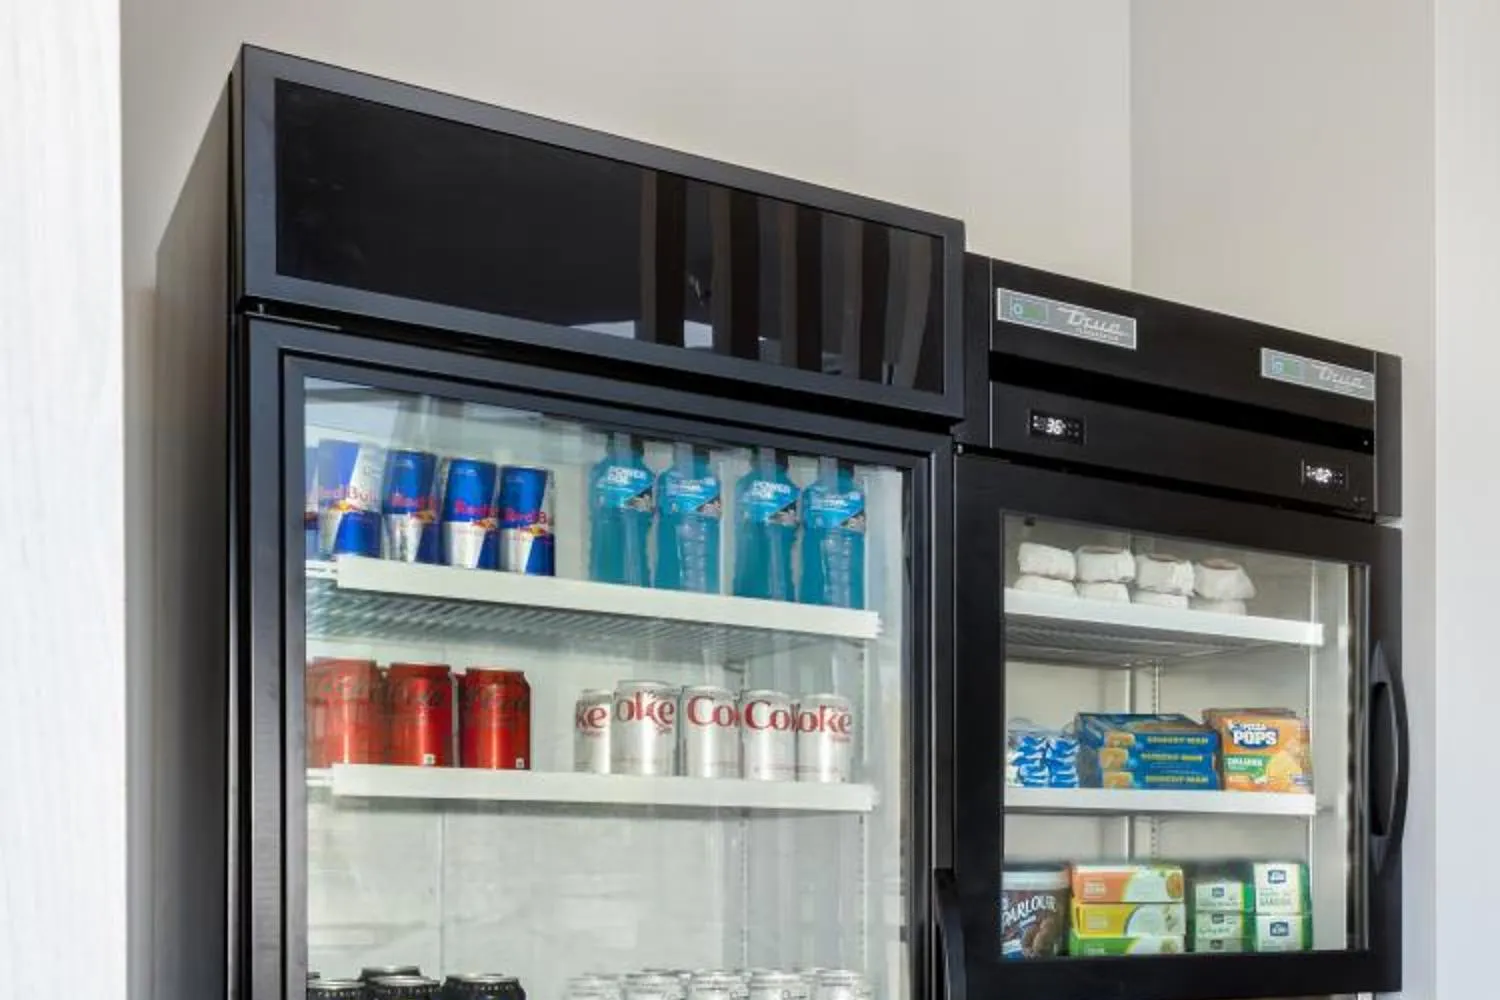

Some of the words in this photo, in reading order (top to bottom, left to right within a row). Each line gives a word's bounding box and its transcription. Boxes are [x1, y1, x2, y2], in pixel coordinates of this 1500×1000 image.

[688, 695, 739, 727] Co
[744, 700, 798, 731] Co
[1233, 731, 1278, 745] POPS
